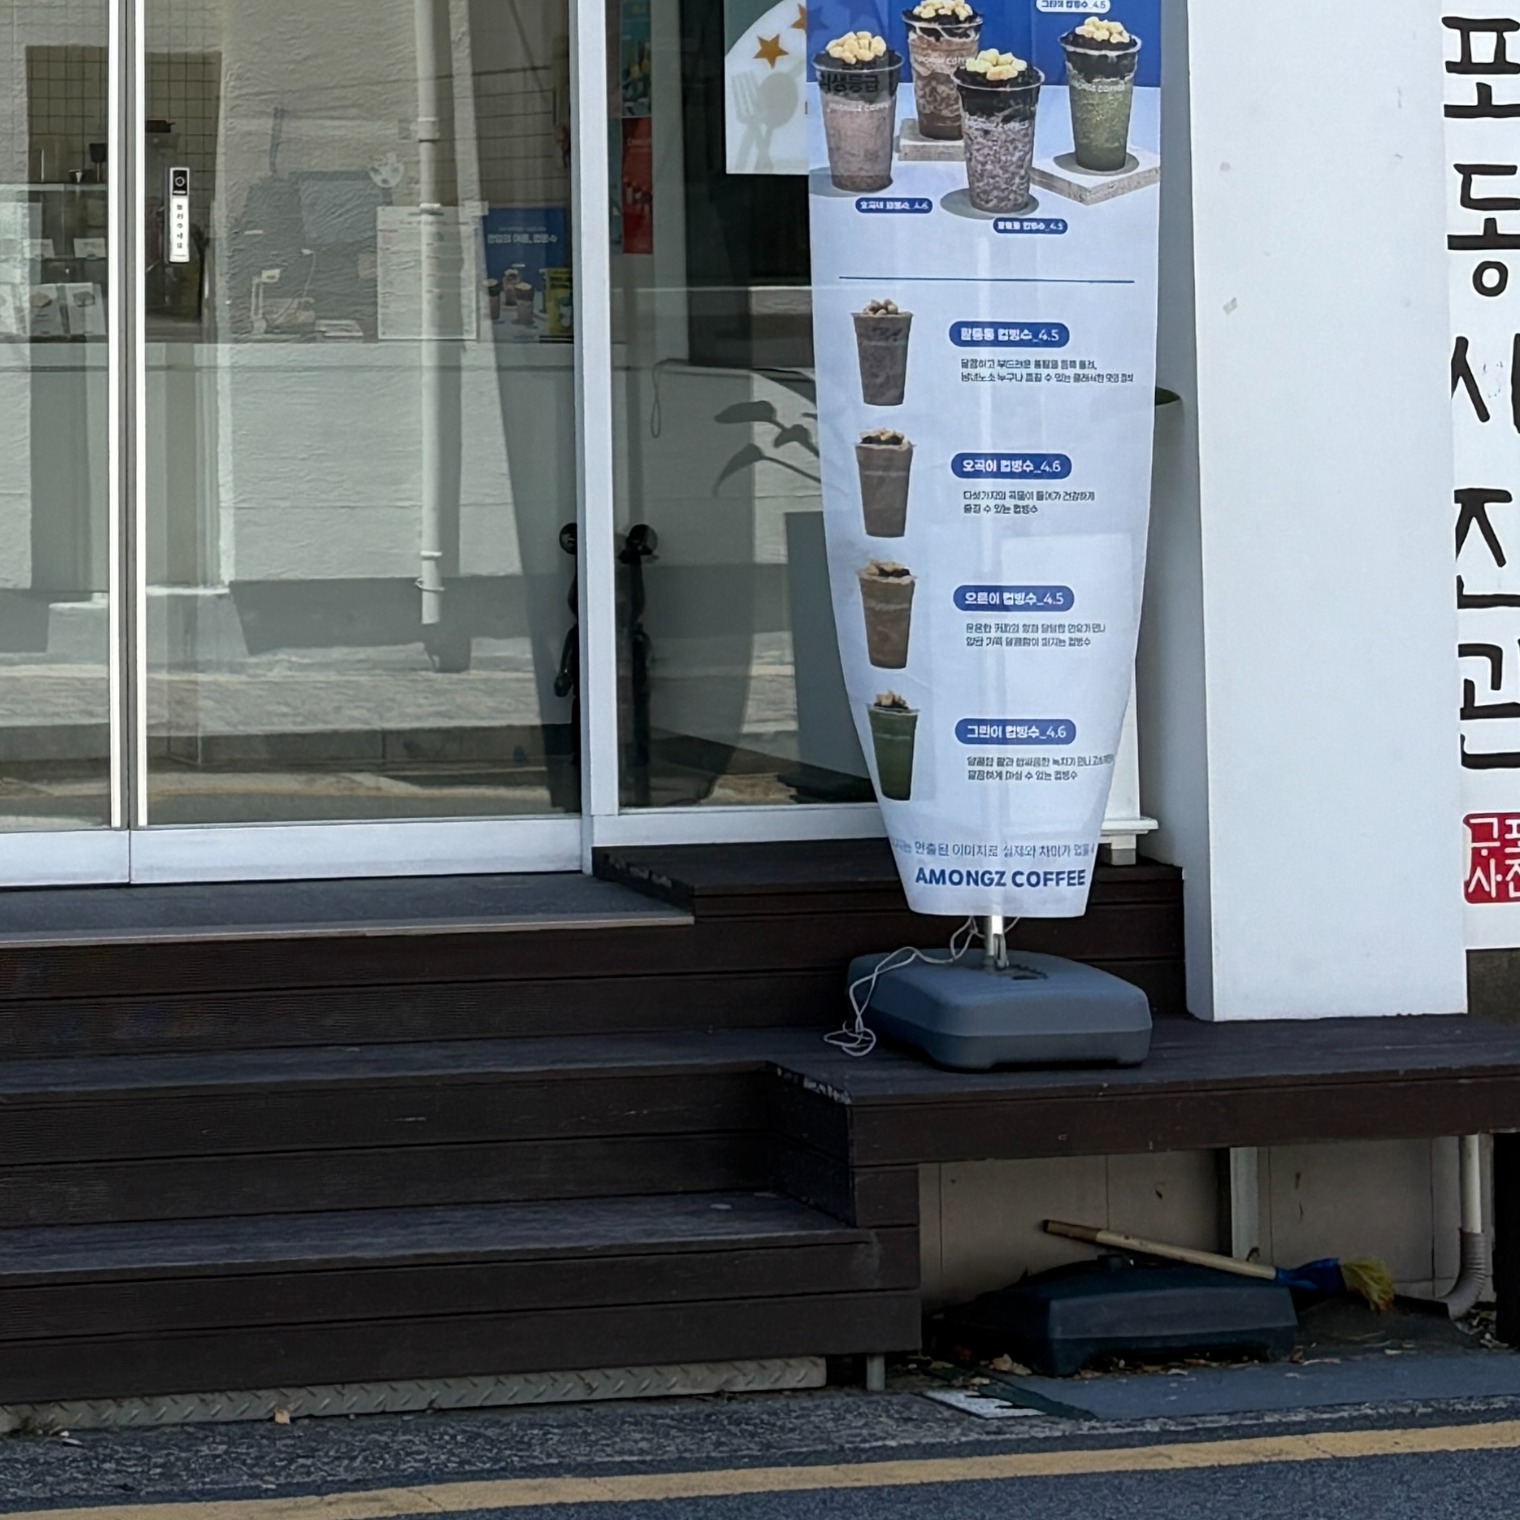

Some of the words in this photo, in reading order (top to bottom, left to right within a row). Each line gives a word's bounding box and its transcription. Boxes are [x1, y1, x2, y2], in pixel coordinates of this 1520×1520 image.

[952, 843, 998, 857] 이미지로
[915, 867, 1007, 887] AMONGZ
[1011, 868, 1087, 888] COFFEE
